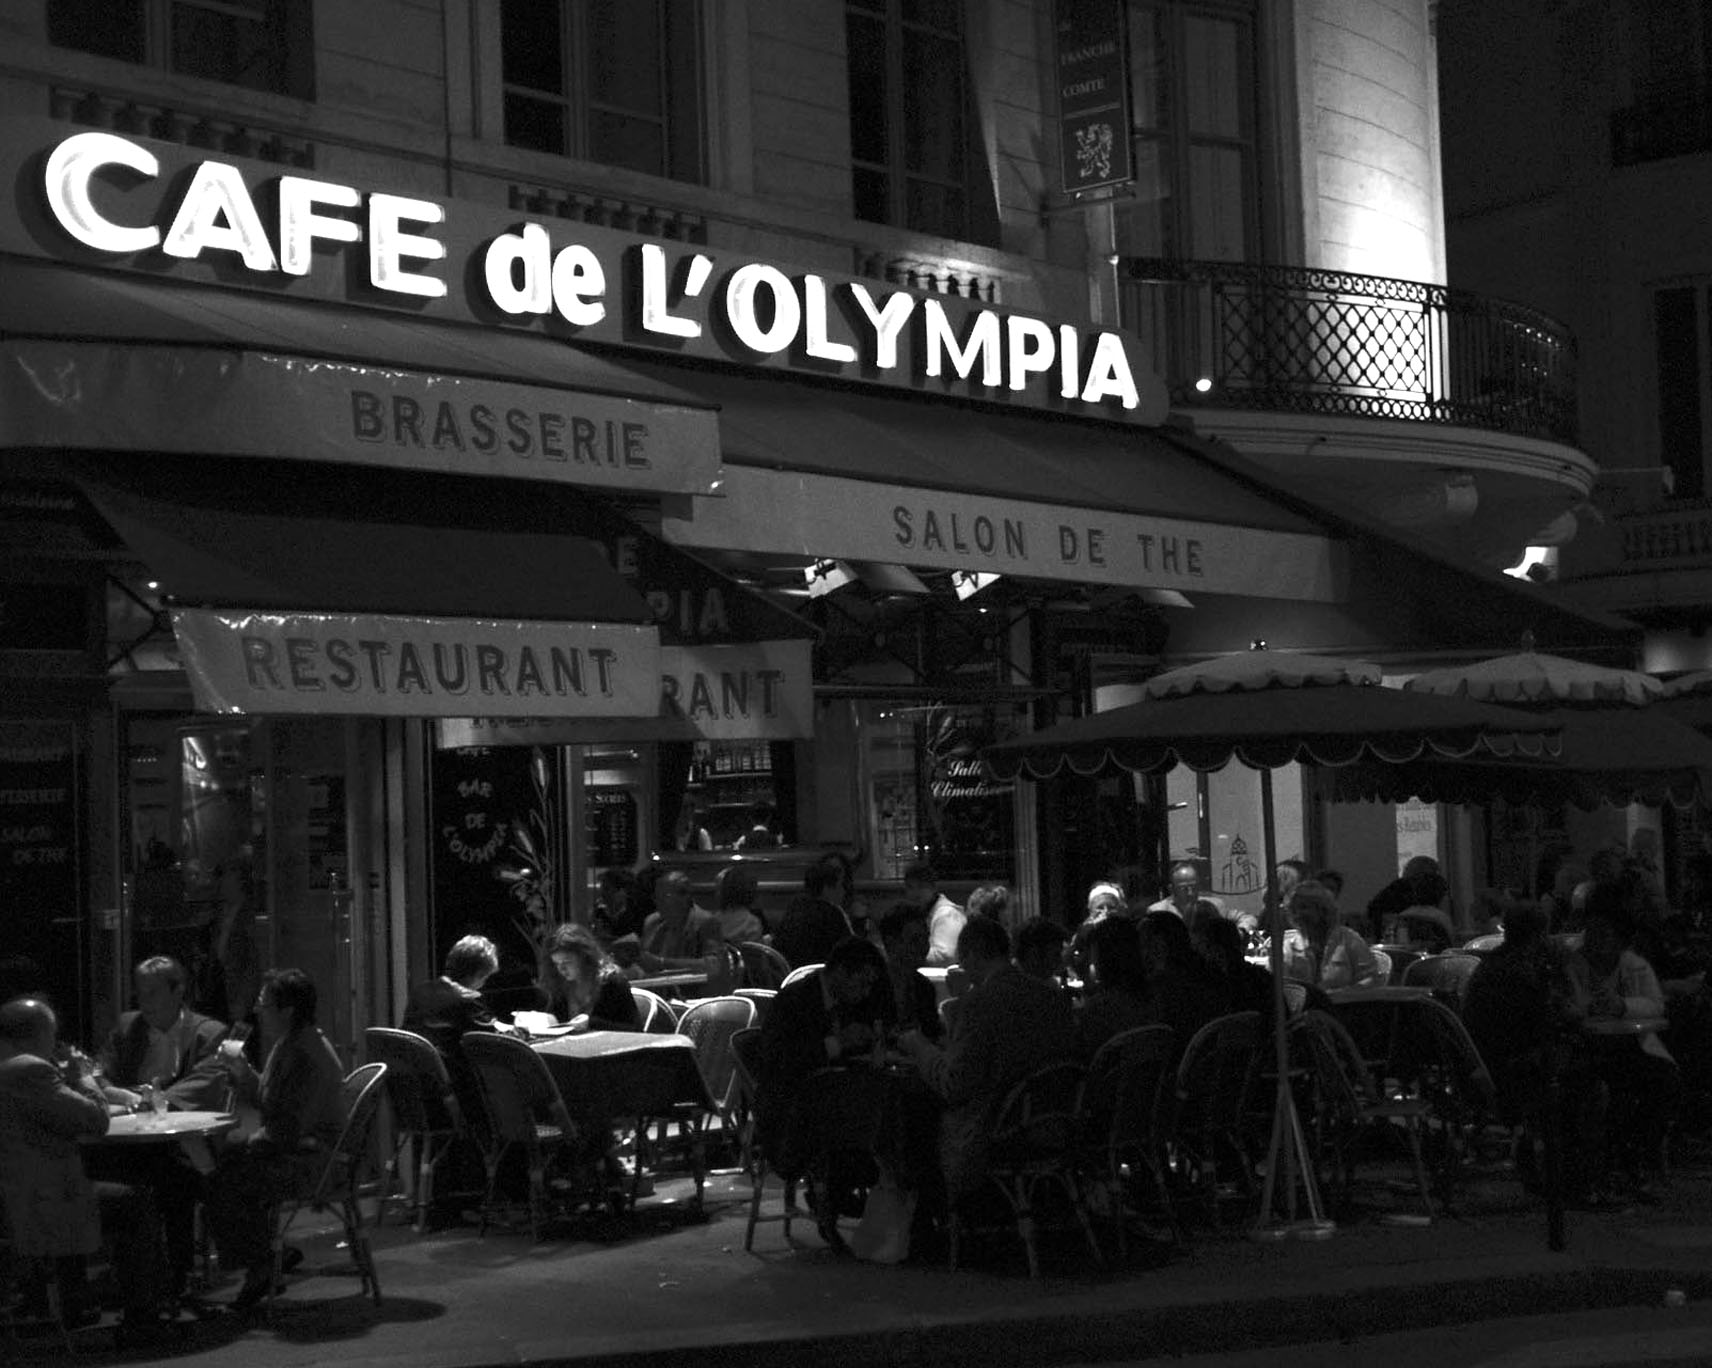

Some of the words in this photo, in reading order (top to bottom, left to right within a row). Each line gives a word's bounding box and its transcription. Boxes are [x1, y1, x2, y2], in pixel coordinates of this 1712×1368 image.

[1062, 77, 1105, 98] COMTE
[45, 130, 448, 299] CAFE
[484, 222, 606, 326] de
[641, 242, 1140, 410] L'OLYMPIA
[350, 389, 653, 470] BRASSERIE
[892, 505, 1029, 562] SALON
[1057, 524, 1108, 567] DE
[1137, 532, 1205, 576] THE
[239, 636, 618, 696] RESTAURANT
